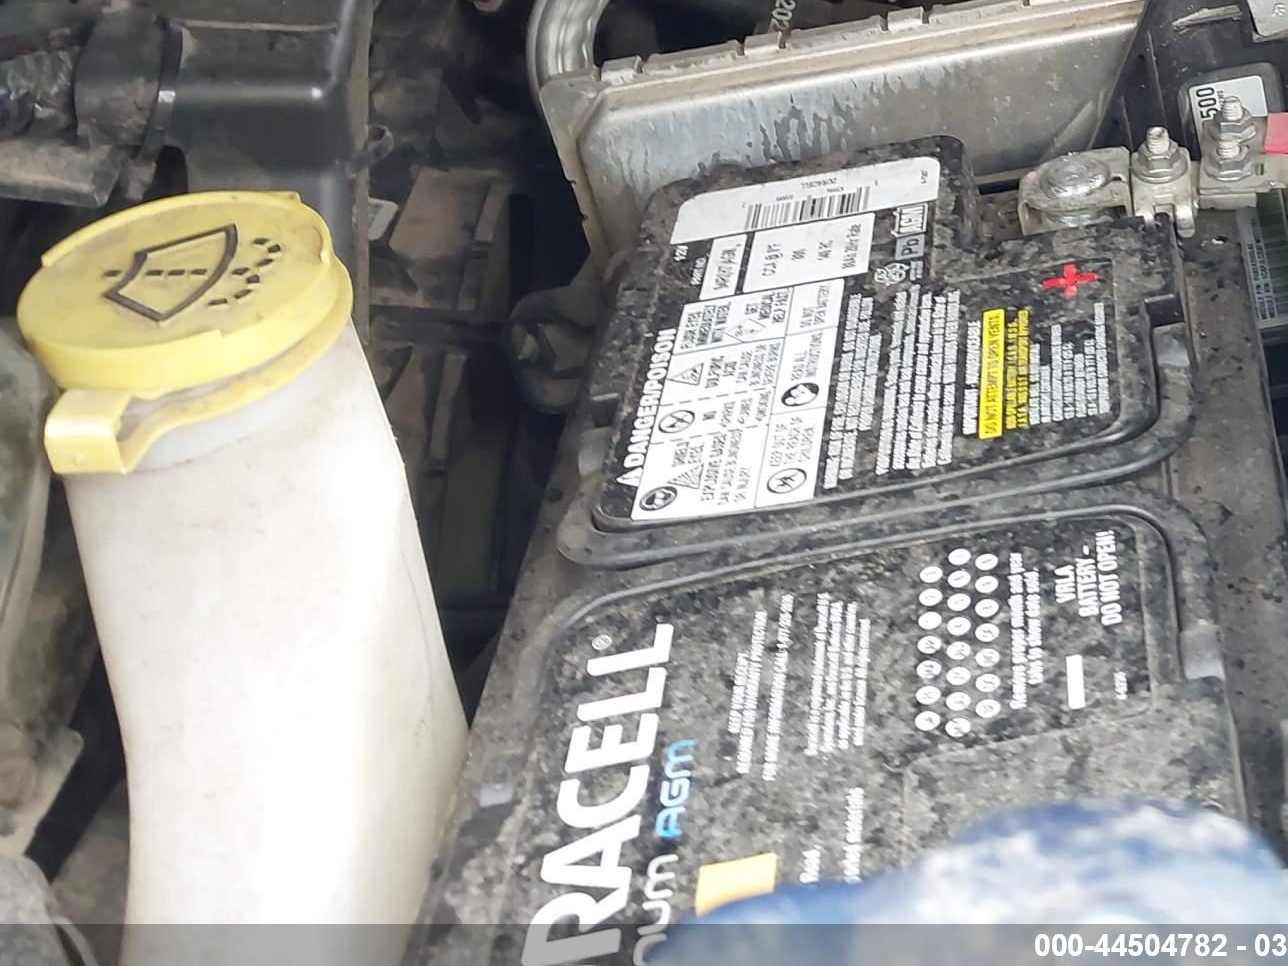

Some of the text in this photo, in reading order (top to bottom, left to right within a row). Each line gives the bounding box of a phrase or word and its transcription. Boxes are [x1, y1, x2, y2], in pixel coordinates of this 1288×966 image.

[899, 204, 924, 234] AGM
[899, 237, 919, 256] Pb
[987, 338, 999, 361] OPEN
[622, 326, 677, 469] DANGER/POISON
[985, 369, 998, 404] ATTEMPT
[962, 386, 978, 435] IMPORTANT
[1055, 565, 1076, 603] VRLA
[1076, 558, 1099, 617] BATTERY
[1096, 530, 1122, 625] DO NOT OPEN!
[1009, 594, 1025, 627] month
[1011, 628, 1027, 664] proper
[1009, 664, 1027, 710] Remove
[653, 738, 699, 840] AGM
